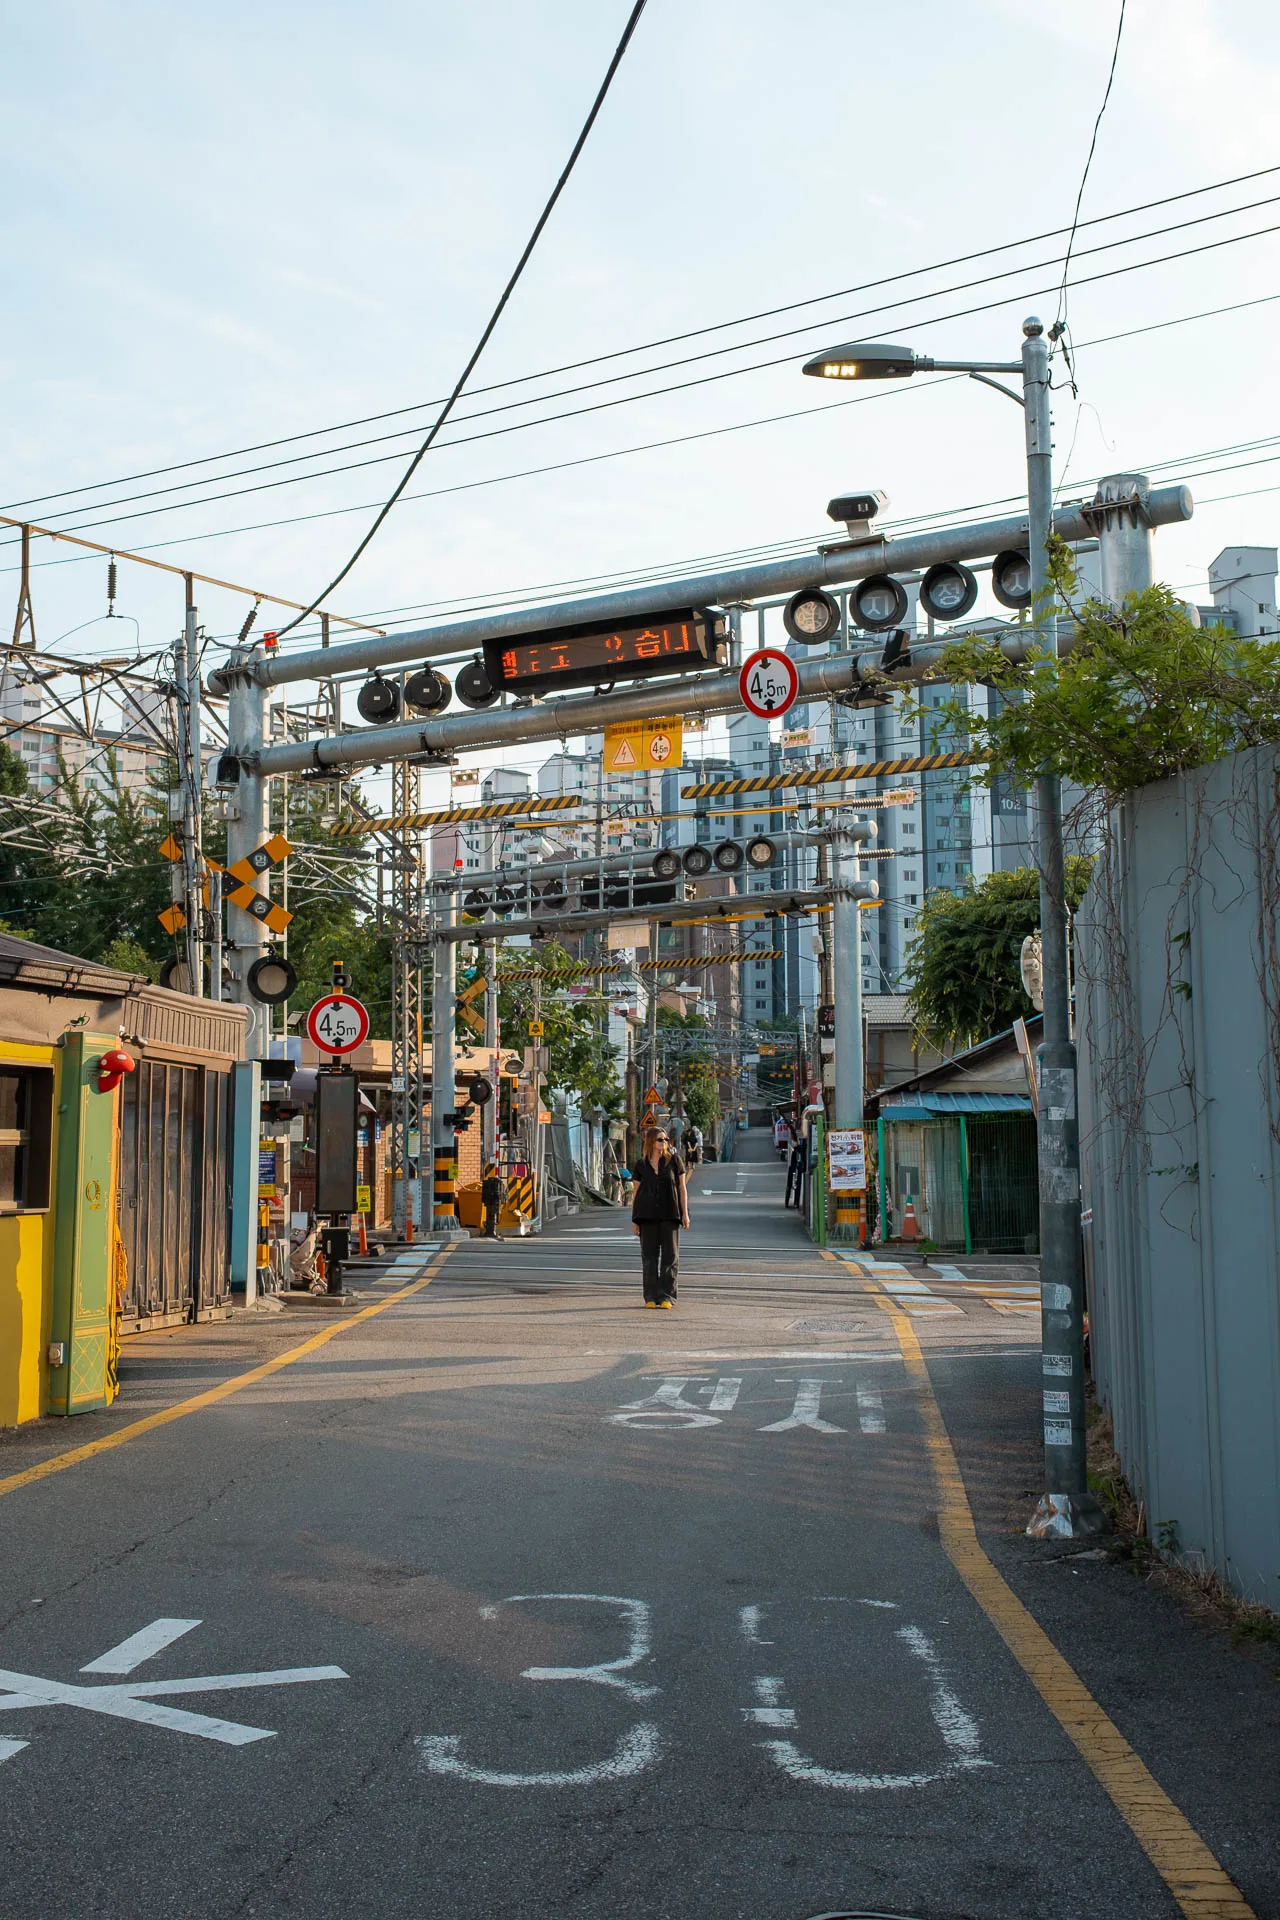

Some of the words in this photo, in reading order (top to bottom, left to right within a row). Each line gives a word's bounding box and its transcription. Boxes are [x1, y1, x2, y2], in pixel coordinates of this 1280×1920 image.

[937, 581, 961, 606] 정
[750, 671, 787, 699] 4.5m
[652, 742, 669, 754] 4.5m
[319, 1013, 357, 1037] 4.5m
[601, 1377, 887, 1433] 정지
[414, 1594, 995, 1791] 30
